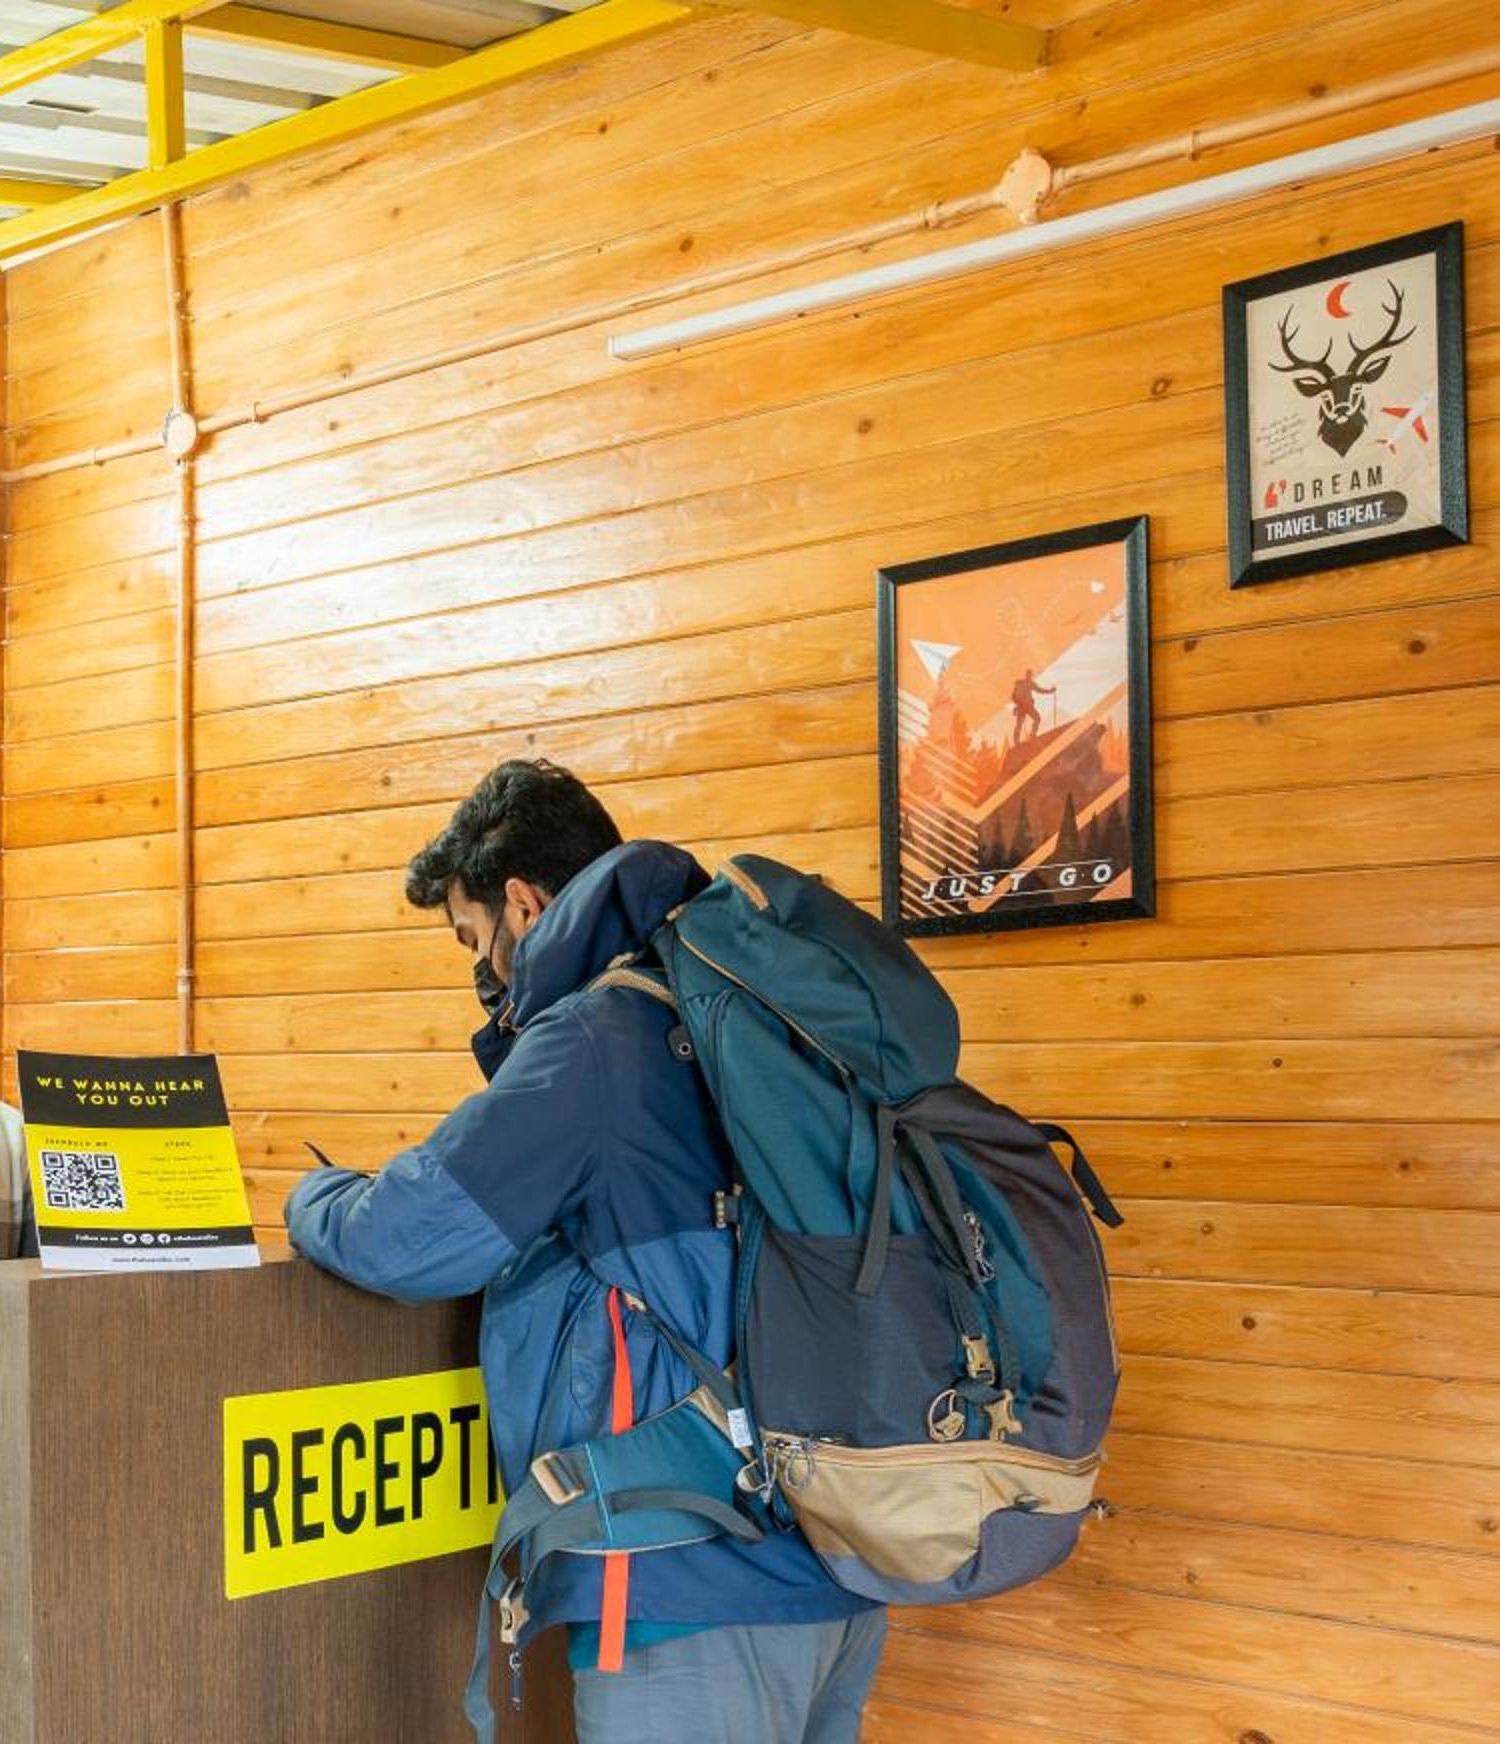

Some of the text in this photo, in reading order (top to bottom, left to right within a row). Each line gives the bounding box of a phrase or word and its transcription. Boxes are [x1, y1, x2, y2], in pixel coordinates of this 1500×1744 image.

[1294, 465, 1383, 503] DREAM
[1265, 501, 1387, 541] TRAVEL. REPEAT.
[921, 863, 1113, 900] JUST GO
[36, 1076, 204, 1092] WE WANNA HEAR
[76, 1093, 169, 1106] YOU OUT
